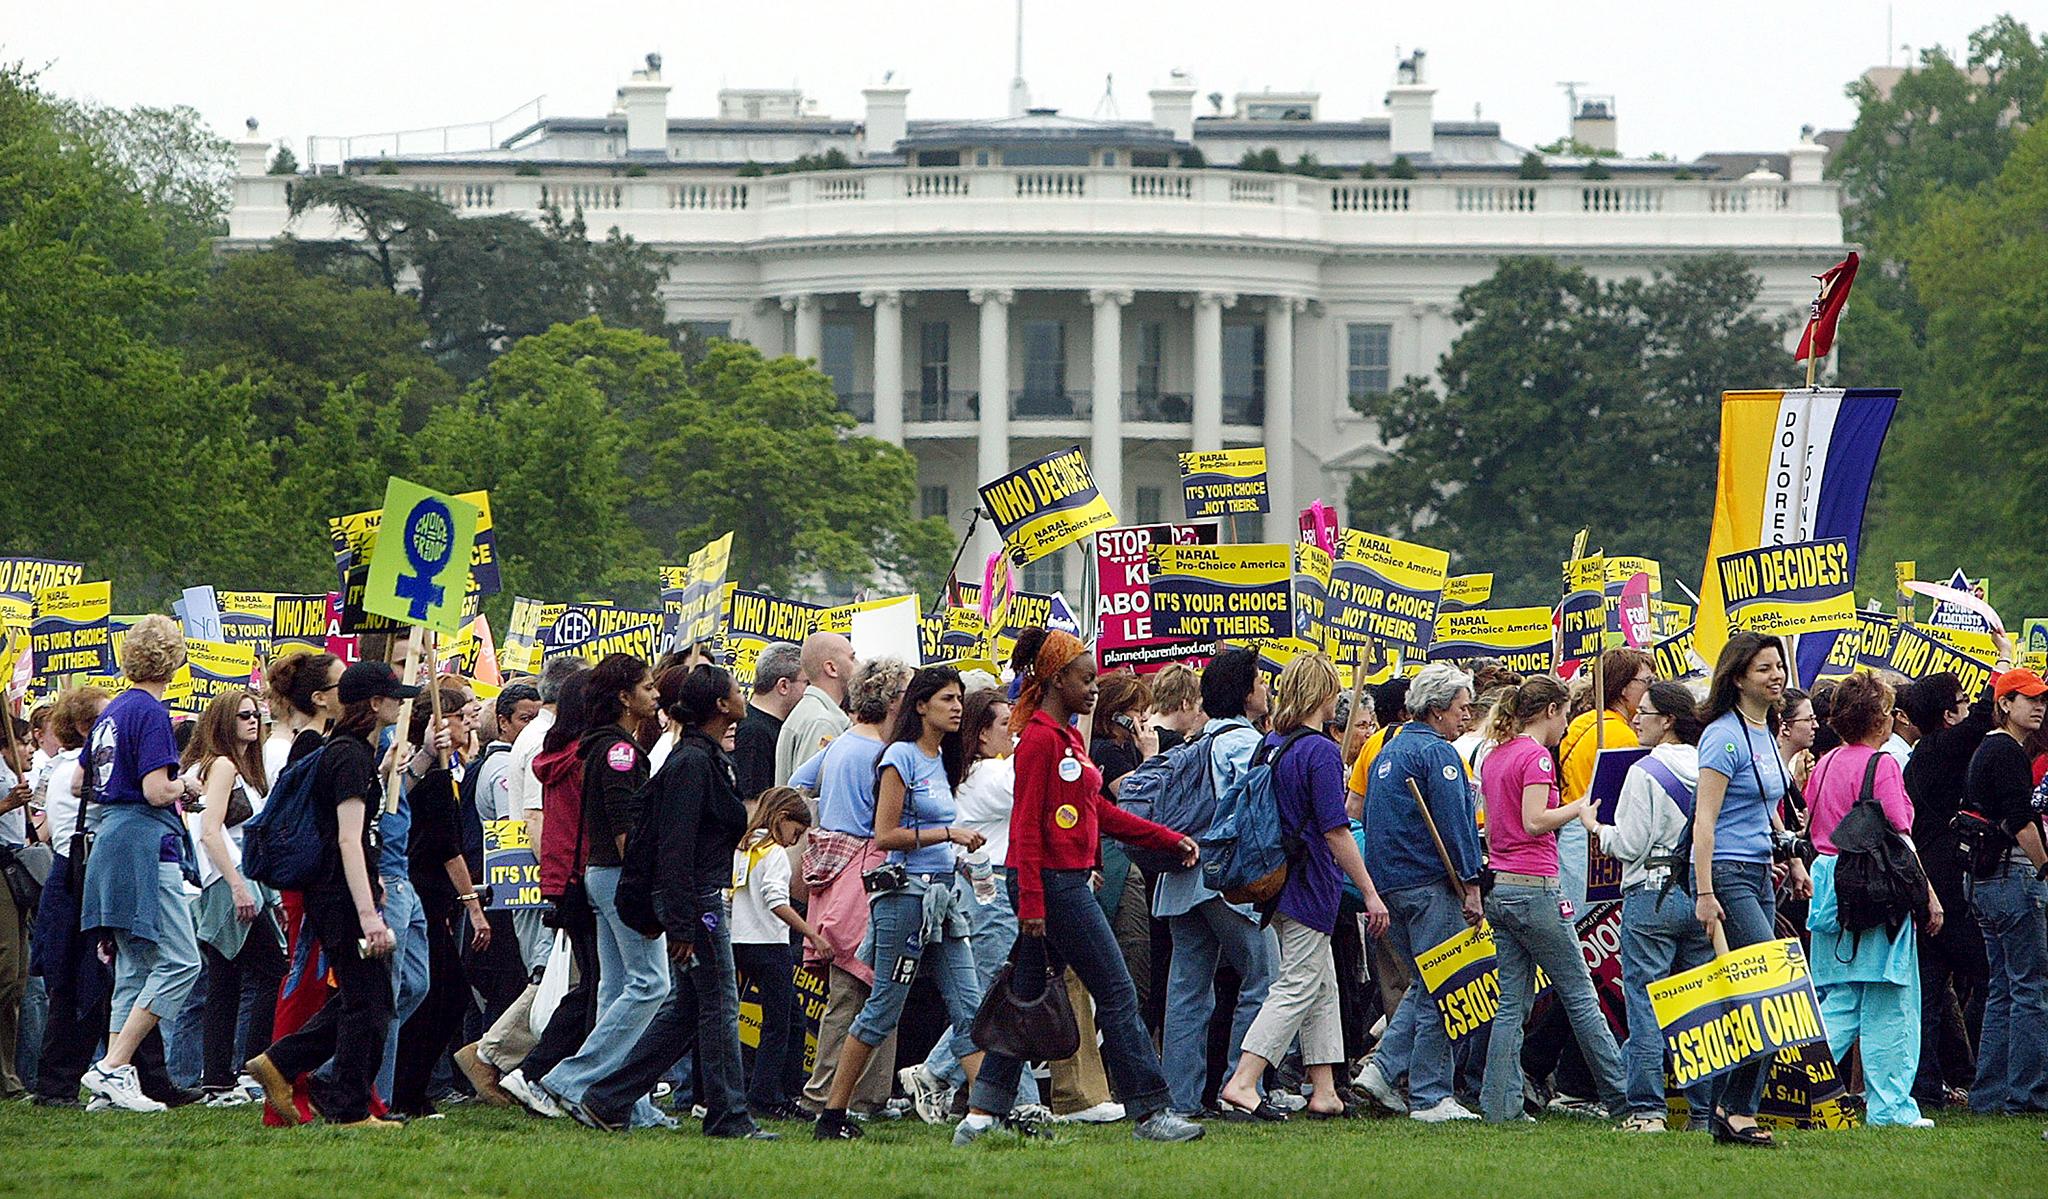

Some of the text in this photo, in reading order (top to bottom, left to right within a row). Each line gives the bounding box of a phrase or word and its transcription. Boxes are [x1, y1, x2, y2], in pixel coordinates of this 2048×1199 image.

[1199, 453, 1229, 462] NARAL
[1200, 461, 1237, 470] Pro-Choice
[985, 450, 1094, 526] WHO DECIDES?
[1773, 412, 1797, 546] DOLORES
[1186, 481, 1266, 500] IT'S YOUR CHOICE
[1197, 498, 1260, 515] ...NOT THEIRS.
[415, 512, 447, 542] CHOICE
[1033, 519, 1069, 540] NARAL
[1037, 520, 1089, 547] Pro-Choice
[1099, 529, 1150, 557] STOP
[1359, 537, 1392, 555] NARAL
[1176, 550, 1219, 560] NARAL
[1176, 560, 1286, 570] Pro-Choice America
[1357, 549, 1442, 578] Pro-Choice America
[1721, 542, 1849, 602] WHO DECIDES?
[82, 598, 107, 607] America
[234, 595, 262, 604] NARAL
[234, 602, 272, 610] Pro-Choice
[1154, 593, 1180, 612] IT'S
[1183, 593, 1224, 613] YOUR
[1228, 592, 1287, 612] CHOICE
[1328, 578, 1435, 622] IT'S YOUR CHOICE
[276, 600, 302, 637] WHO
[733, 594, 767, 634] WHO
[767, 601, 806, 641] DECID
[1007, 595, 1051, 630] CIDES?
[1450, 615, 1489, 626] NARAL
[1566, 610, 1583, 632] IT'S
[1750, 611, 1783, 624] NARAL
[1751, 612, 1854, 632] Pro-Choice America
[239, 623, 268, 638] YOUR
[555, 612, 591, 645] KEEP
[1168, 616, 1210, 635] ...NOT
[1213, 615, 1275, 635] THEIRS.
[1331, 606, 1367, 629] ...NOT
[1368, 612, 1418, 643] THEIRS.
[1450, 623, 1548, 636] Pro-Choice America
[50, 631, 72, 650] YOUR
[74, 627, 108, 647] CHOICE
[220, 656, 250, 667] America
[1104, 641, 1216, 666] plannedparenthood.org
[1501, 652, 1550, 672] CHOICE
[1889, 629, 1931, 679] WHO
[1925, 647, 1991, 704] DECIDE
[191, 677, 209, 693] OUR
[490, 866, 520, 884] IT'S
[505, 887, 541, 905] ...NO
[1422, 941, 1463, 971] America
[1653, 955, 1766, 1001] Pro-Choice America
[1727, 964, 1768, 984] NARAL
[1438, 972, 1500, 1041] CIDES?
[1668, 990, 1822, 1085] WHO DECIDES?
[1806, 1060, 1836, 1084] IT'S
[1776, 1085, 1806, 1105] IT'S
